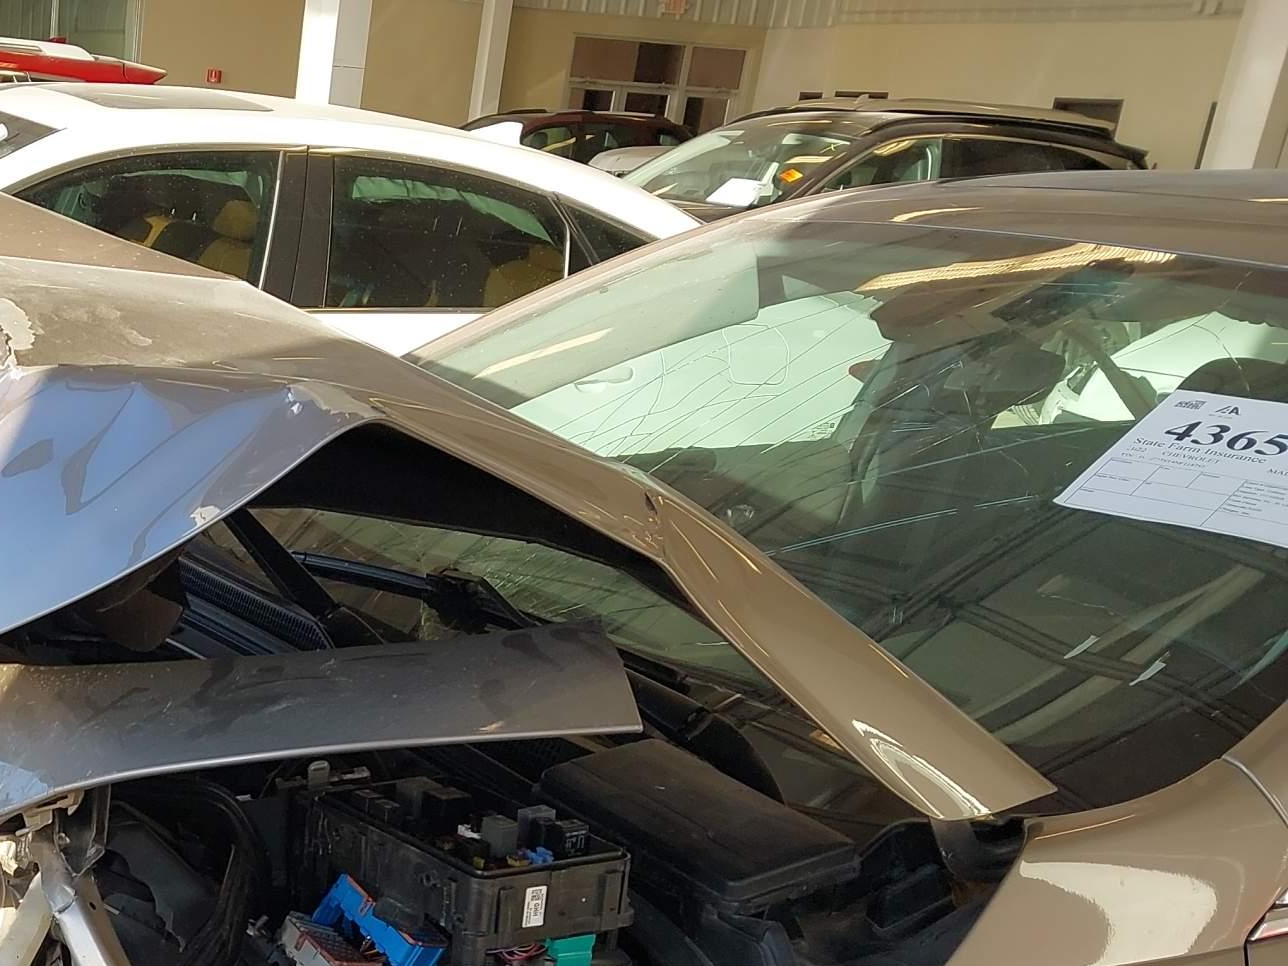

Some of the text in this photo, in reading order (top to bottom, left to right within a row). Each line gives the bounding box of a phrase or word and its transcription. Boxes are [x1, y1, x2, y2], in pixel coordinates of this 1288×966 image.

[1133, 437, 1166, 448] State
[1168, 442, 1201, 454] Farm
[1205, 448, 1268, 464] Insurance
